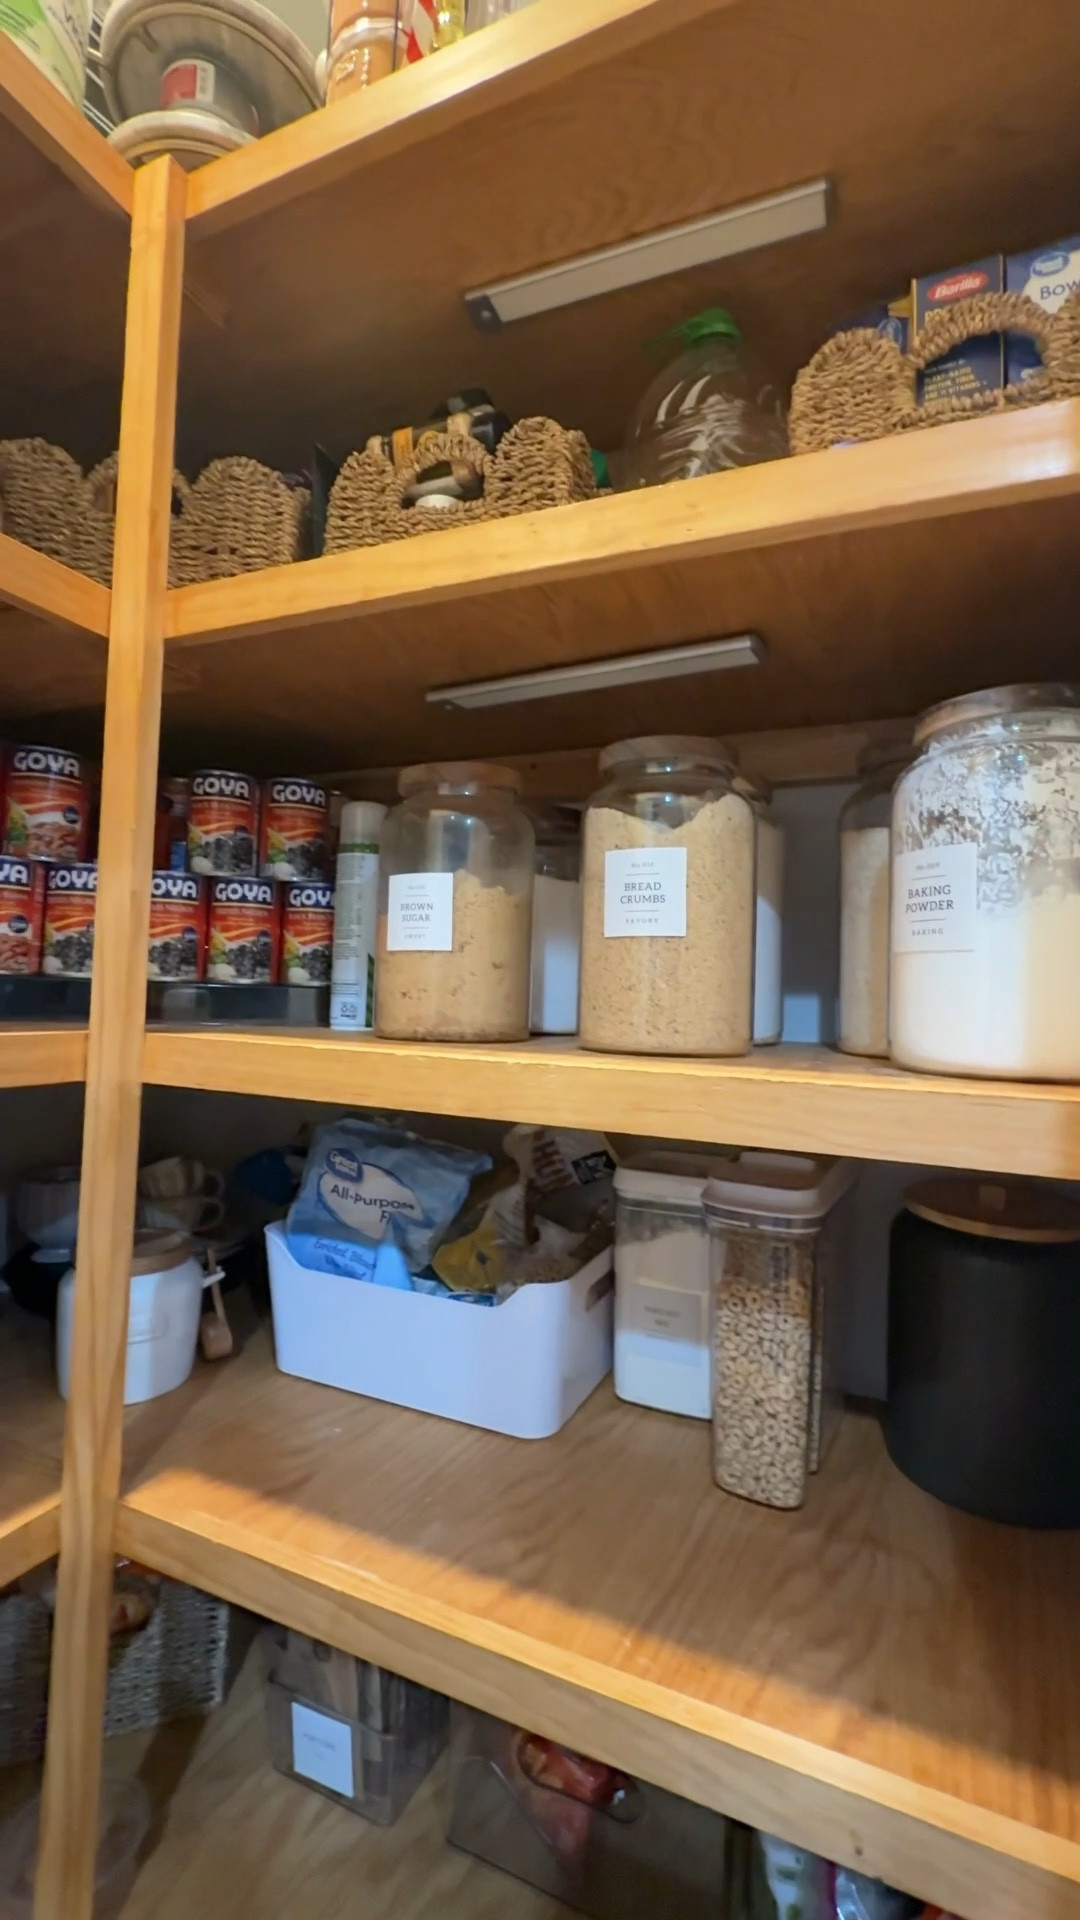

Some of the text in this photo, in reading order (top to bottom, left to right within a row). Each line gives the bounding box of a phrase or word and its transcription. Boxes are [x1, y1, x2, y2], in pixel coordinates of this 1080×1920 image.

[934, 276, 981, 299] Barilla
[13, 750, 80, 777] GOYA
[193, 776, 250, 799] GOYA
[272, 784, 327, 807] GOYA
[0, 863, 28, 884] YA
[151, 877, 197, 898] OYA
[215, 883, 272, 902] GOYA
[624, 882, 662, 892] BREAD
[908, 884, 952, 899] BAKING
[289, 888, 332, 907] GOY
[400, 903, 434, 911] BROWN
[620, 894, 666, 904] CRUMBS
[905, 899, 955, 913] POWDER
[401, 913, 431, 922] SUGAR
[911, 927, 944, 936] BAKING
